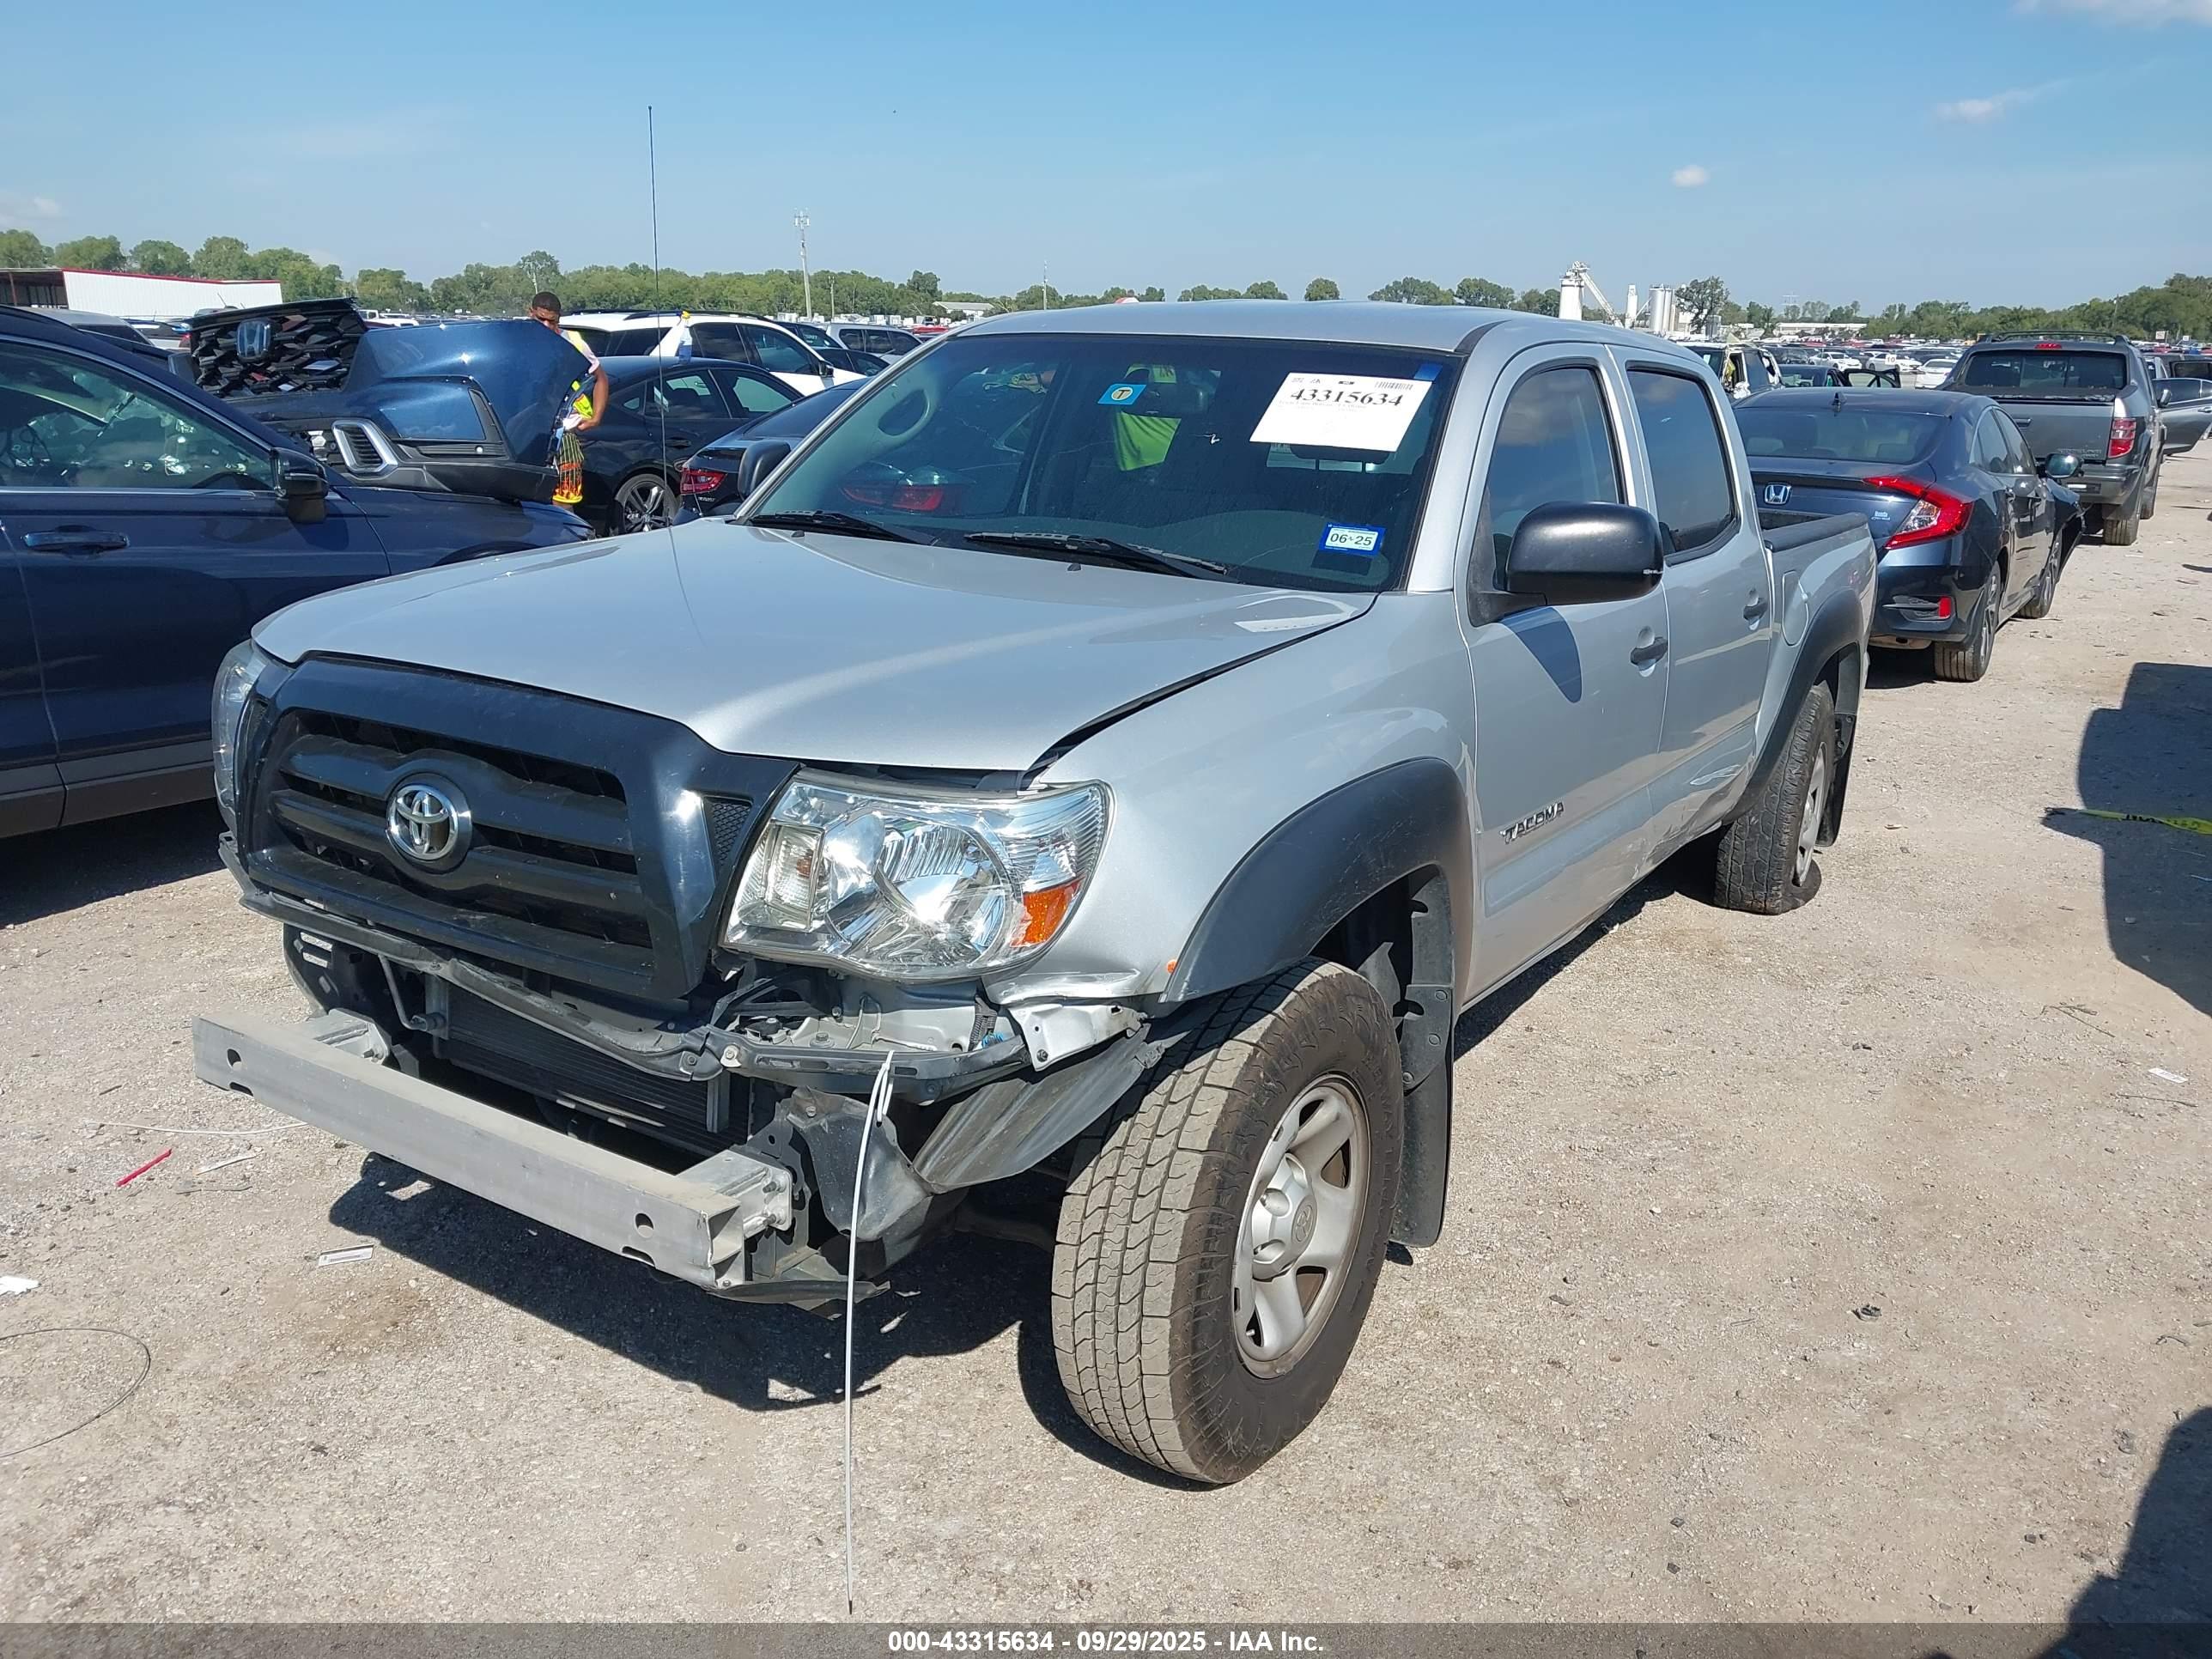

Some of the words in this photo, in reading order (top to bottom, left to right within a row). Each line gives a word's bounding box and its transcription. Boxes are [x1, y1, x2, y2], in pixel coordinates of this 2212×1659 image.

[1291, 387, 1404, 407] 43315634
[1330, 532, 1348, 544] 06
[1354, 535, 1373, 546] 25
[1501, 801, 1565, 842] TACOMA
